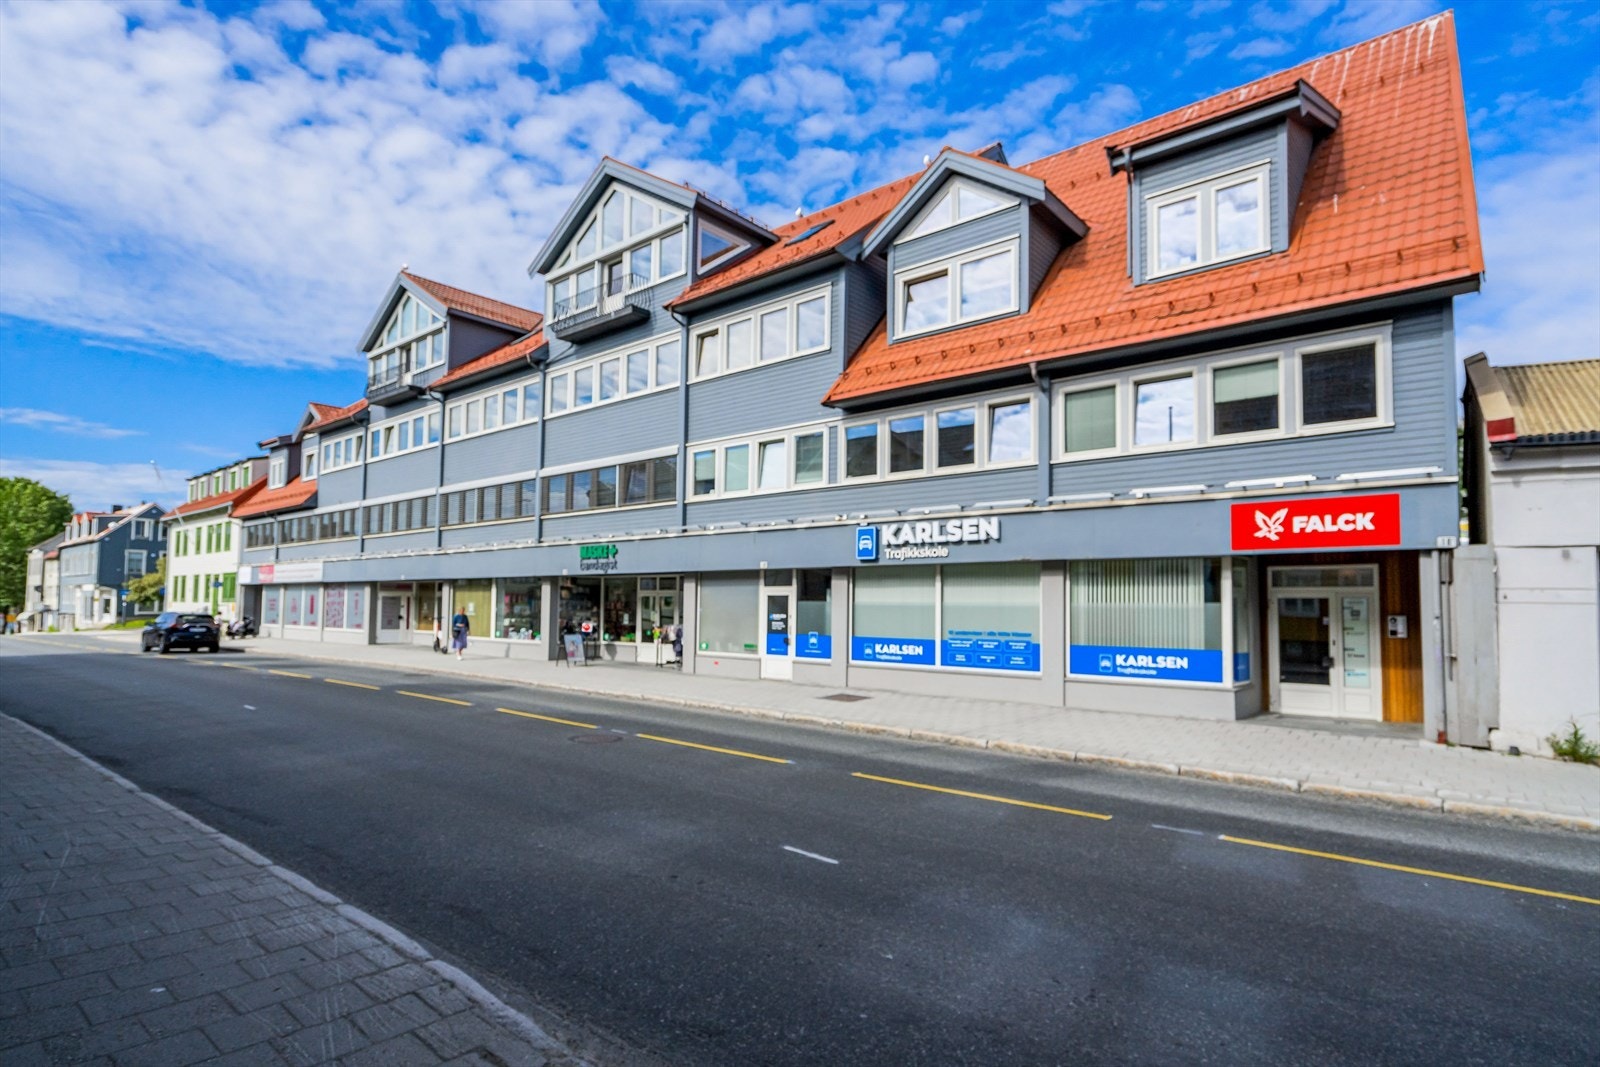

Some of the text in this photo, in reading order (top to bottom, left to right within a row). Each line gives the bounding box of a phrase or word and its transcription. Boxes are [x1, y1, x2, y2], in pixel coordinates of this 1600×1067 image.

[1292, 512, 1376, 533] FALCK
[881, 517, 1000, 545] KARLSEN
[884, 546, 949, 560] Trafikkskole
[875, 643, 923, 656] KARLSEN
[1115, 653, 1189, 669] KARLSEN
